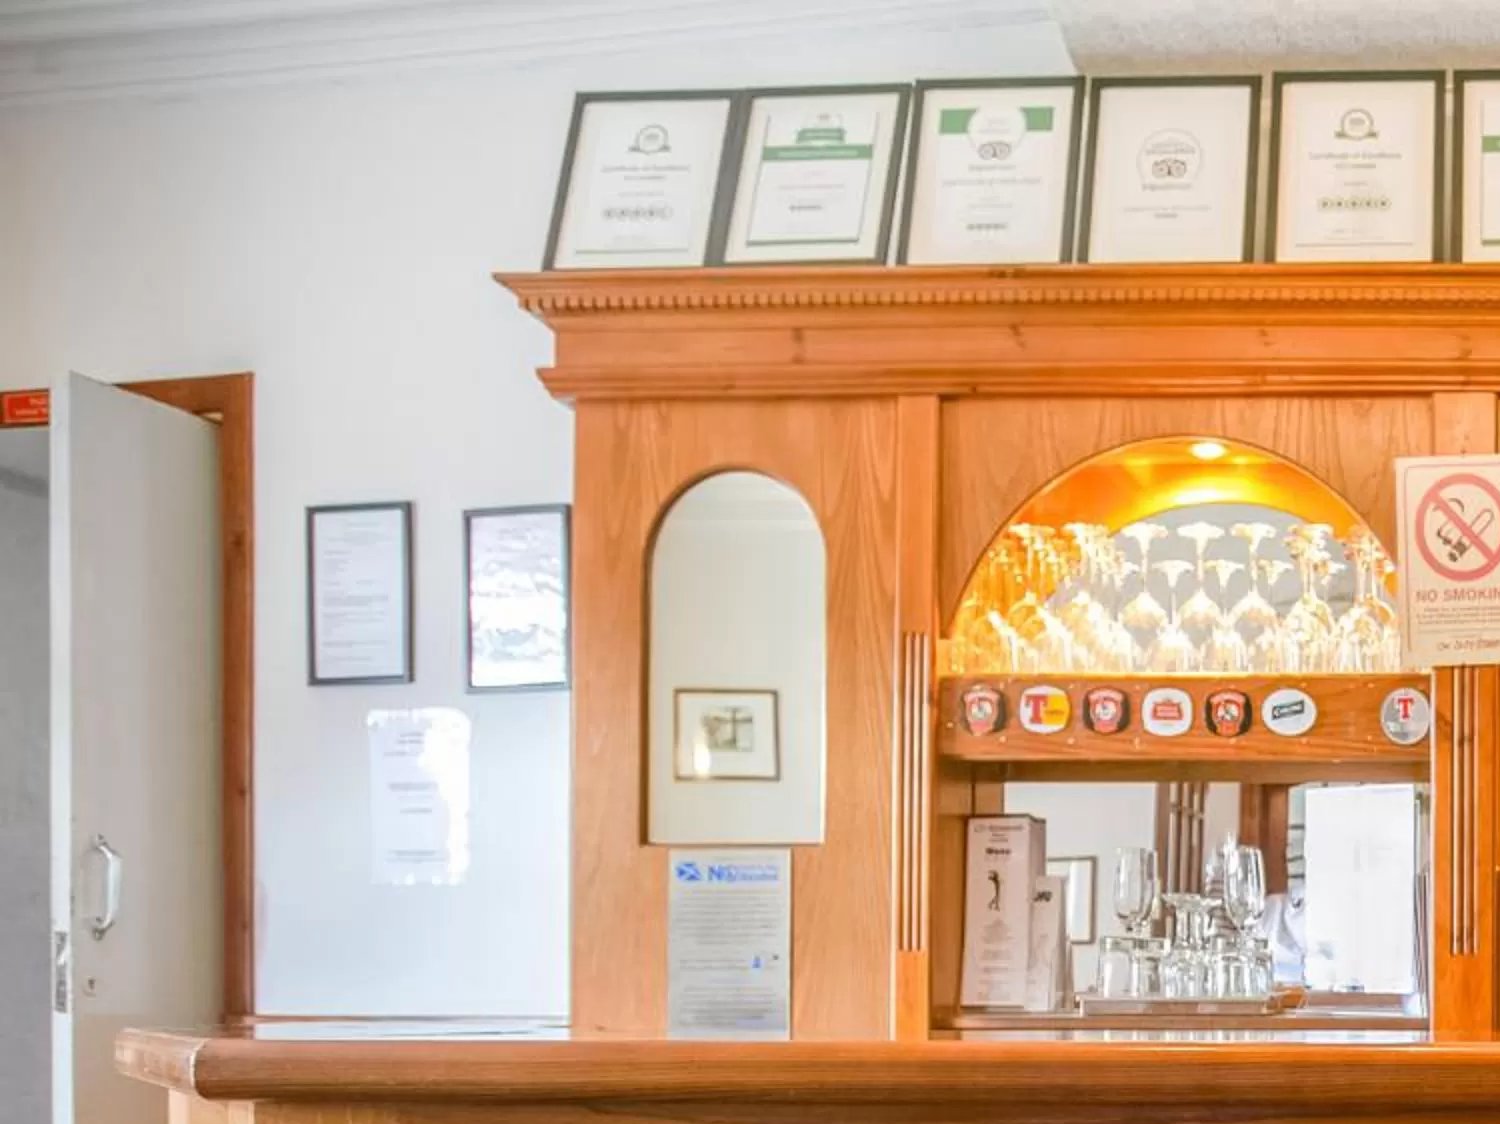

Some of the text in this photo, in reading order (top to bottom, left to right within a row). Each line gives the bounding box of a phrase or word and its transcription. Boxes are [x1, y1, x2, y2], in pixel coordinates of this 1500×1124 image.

[1415, 589, 1438, 603] NO
[1025, 694, 1048, 725] T
[1396, 696, 1415, 720] T
